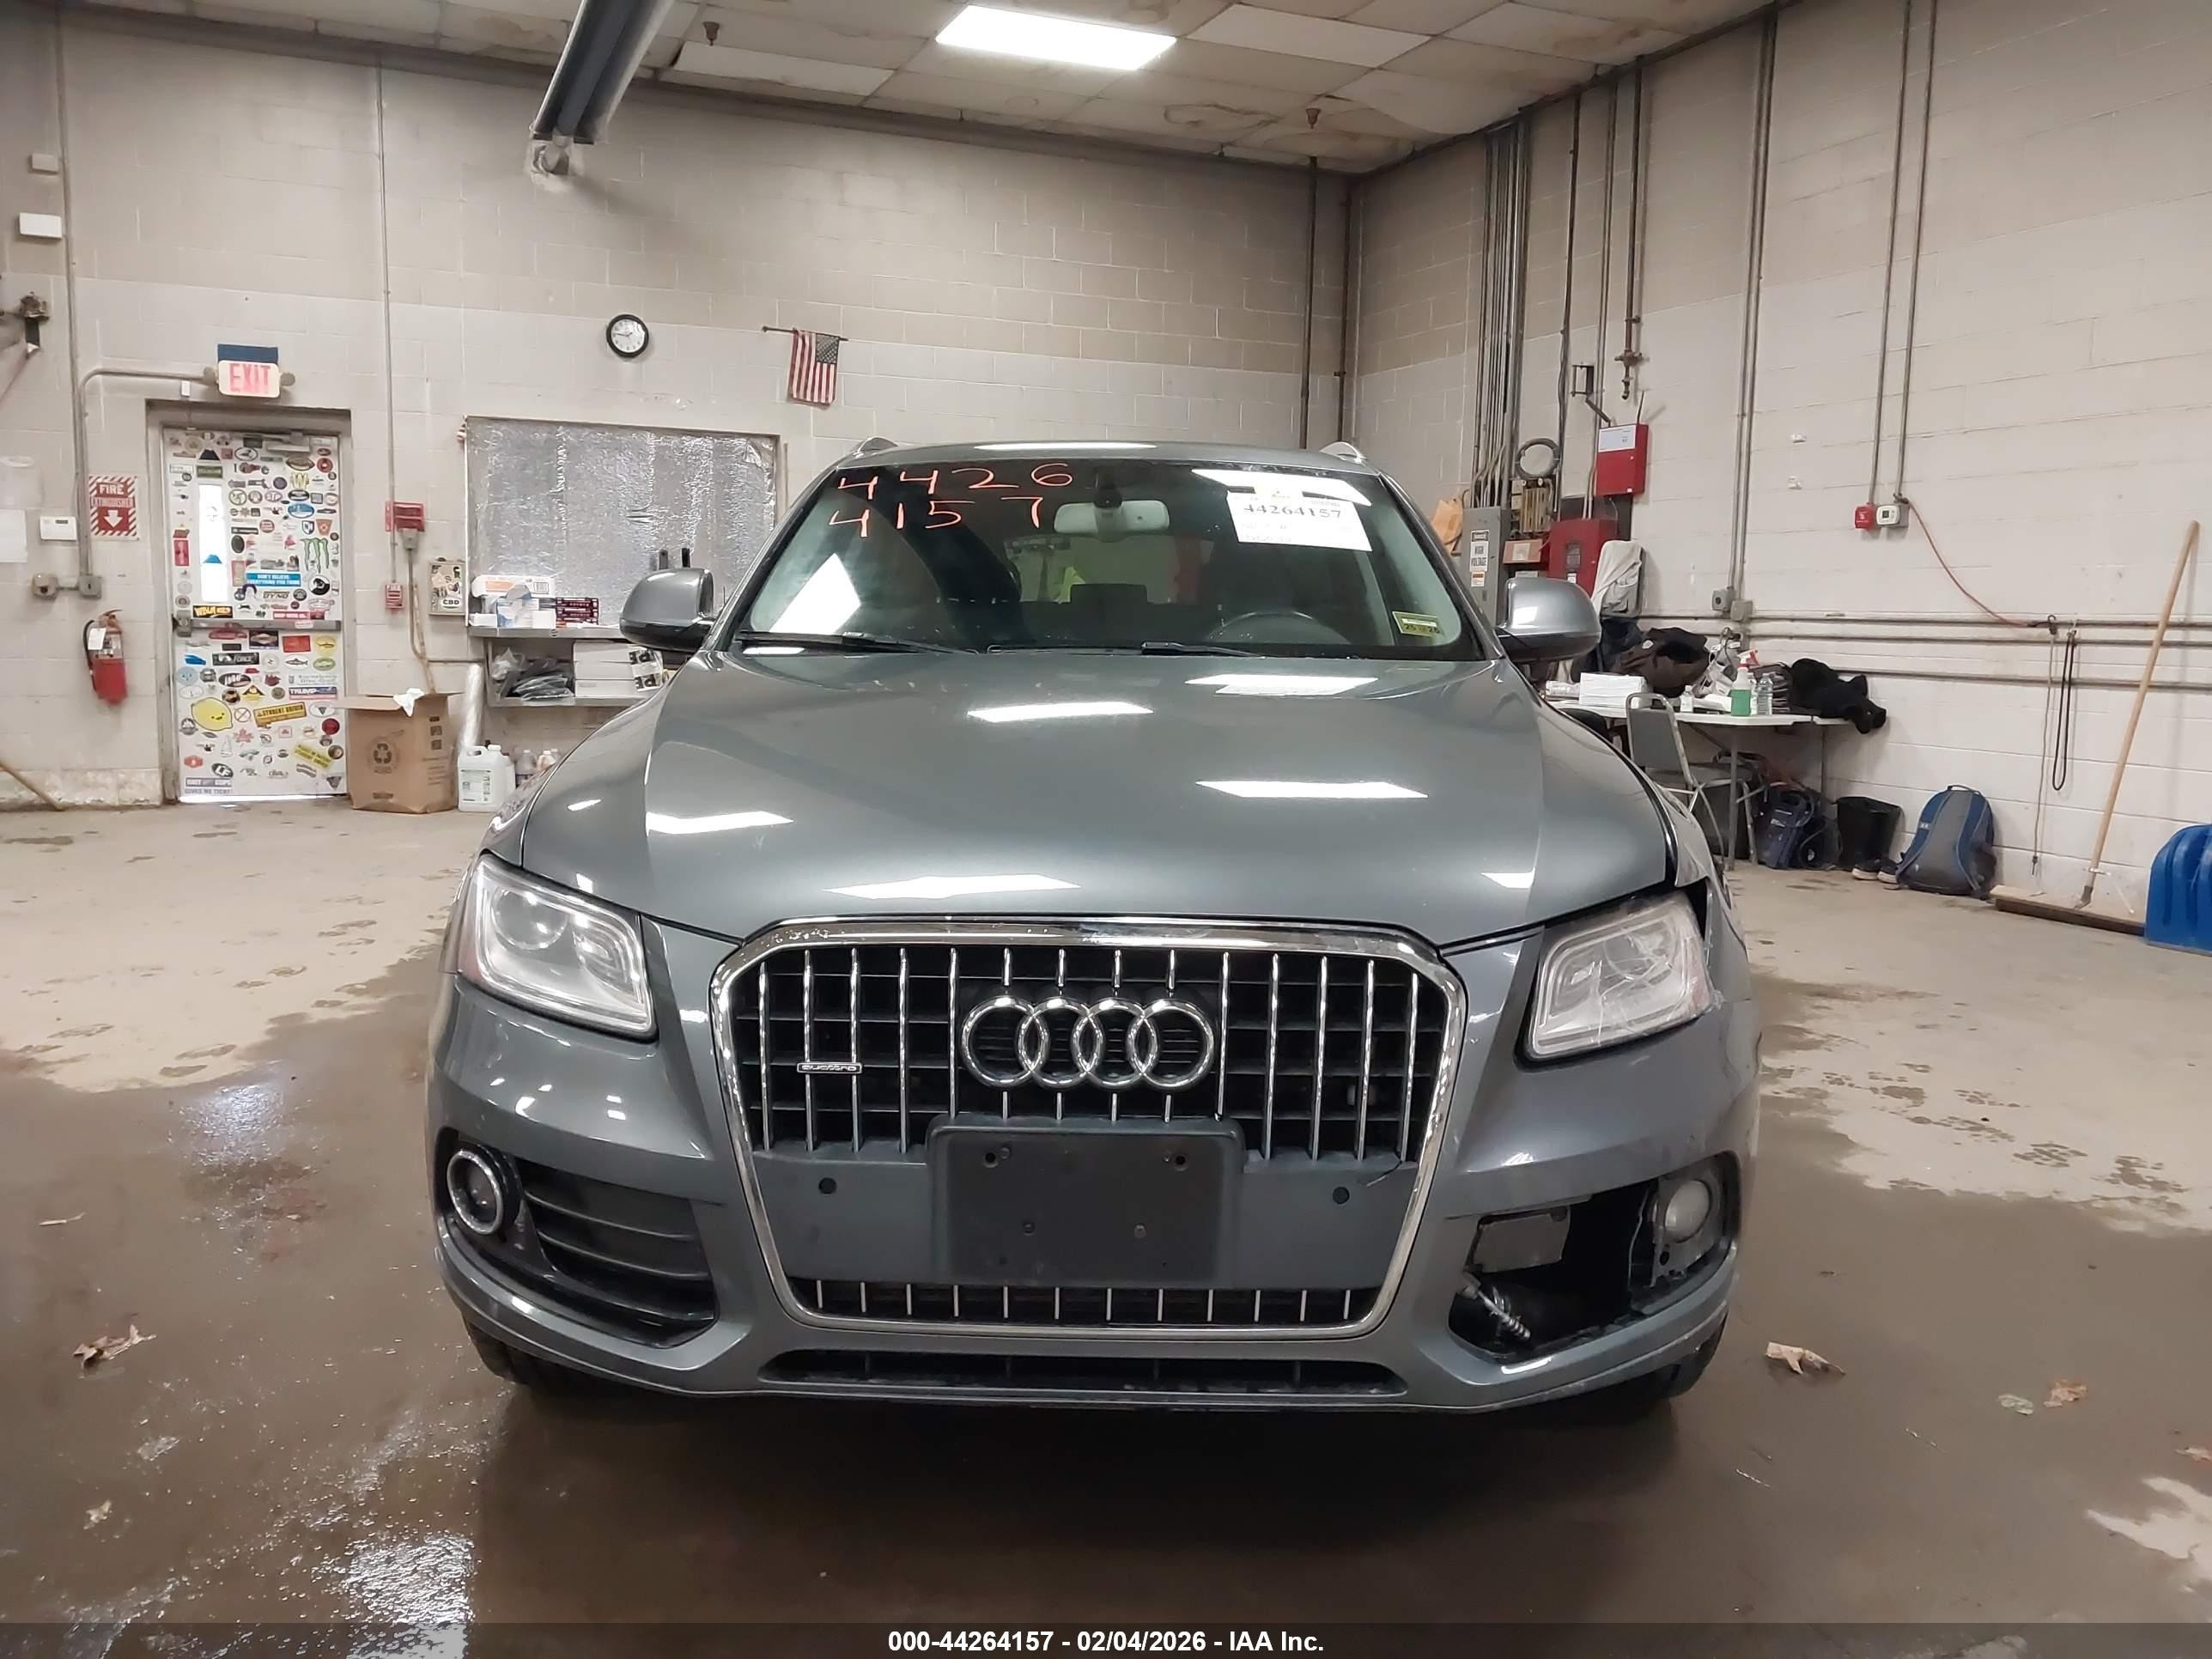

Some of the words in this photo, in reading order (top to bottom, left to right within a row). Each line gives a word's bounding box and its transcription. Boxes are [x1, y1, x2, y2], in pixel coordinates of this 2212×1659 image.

[229, 363, 270, 393] EXIT
[99, 483, 125, 495] FIRE
[1243, 503, 1341, 519] 44264157
